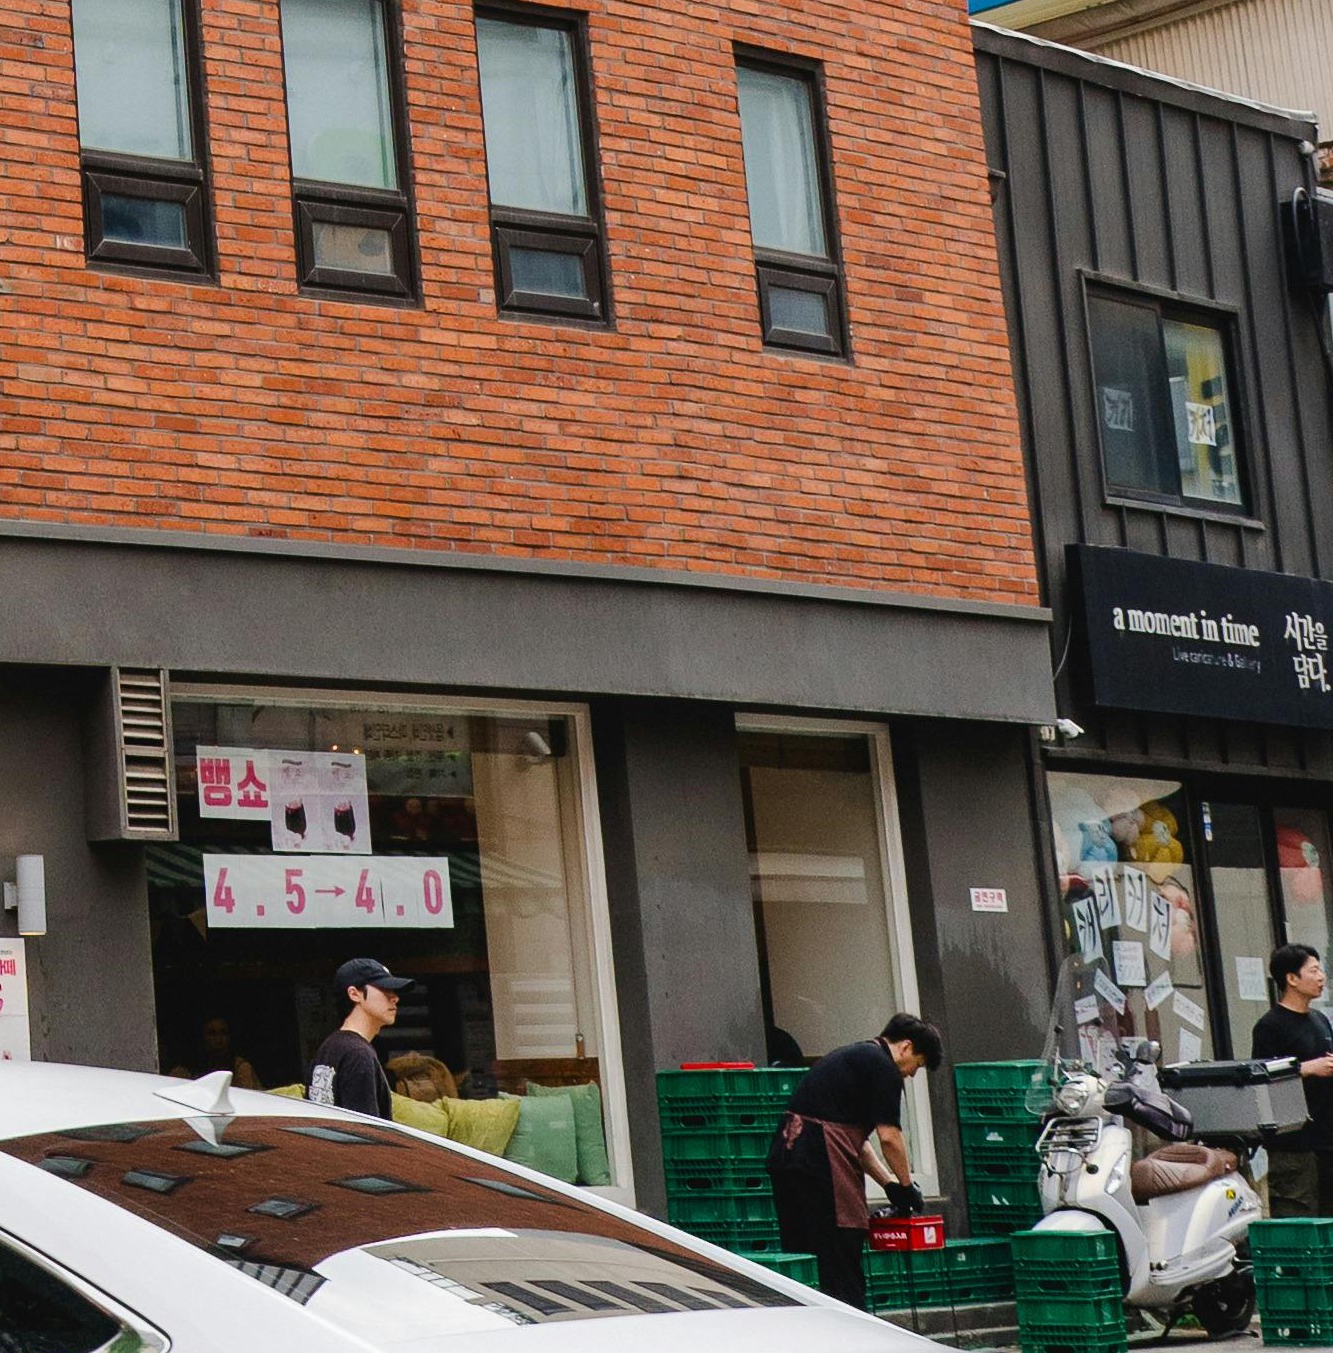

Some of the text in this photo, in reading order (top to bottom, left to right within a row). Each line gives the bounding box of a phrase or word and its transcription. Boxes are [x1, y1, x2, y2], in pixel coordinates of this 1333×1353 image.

[1113, 607, 1260, 647] a moment in time
[1284, 611, 1328, 651] 시간을
[200, 758, 269, 808] 뱅쇼
